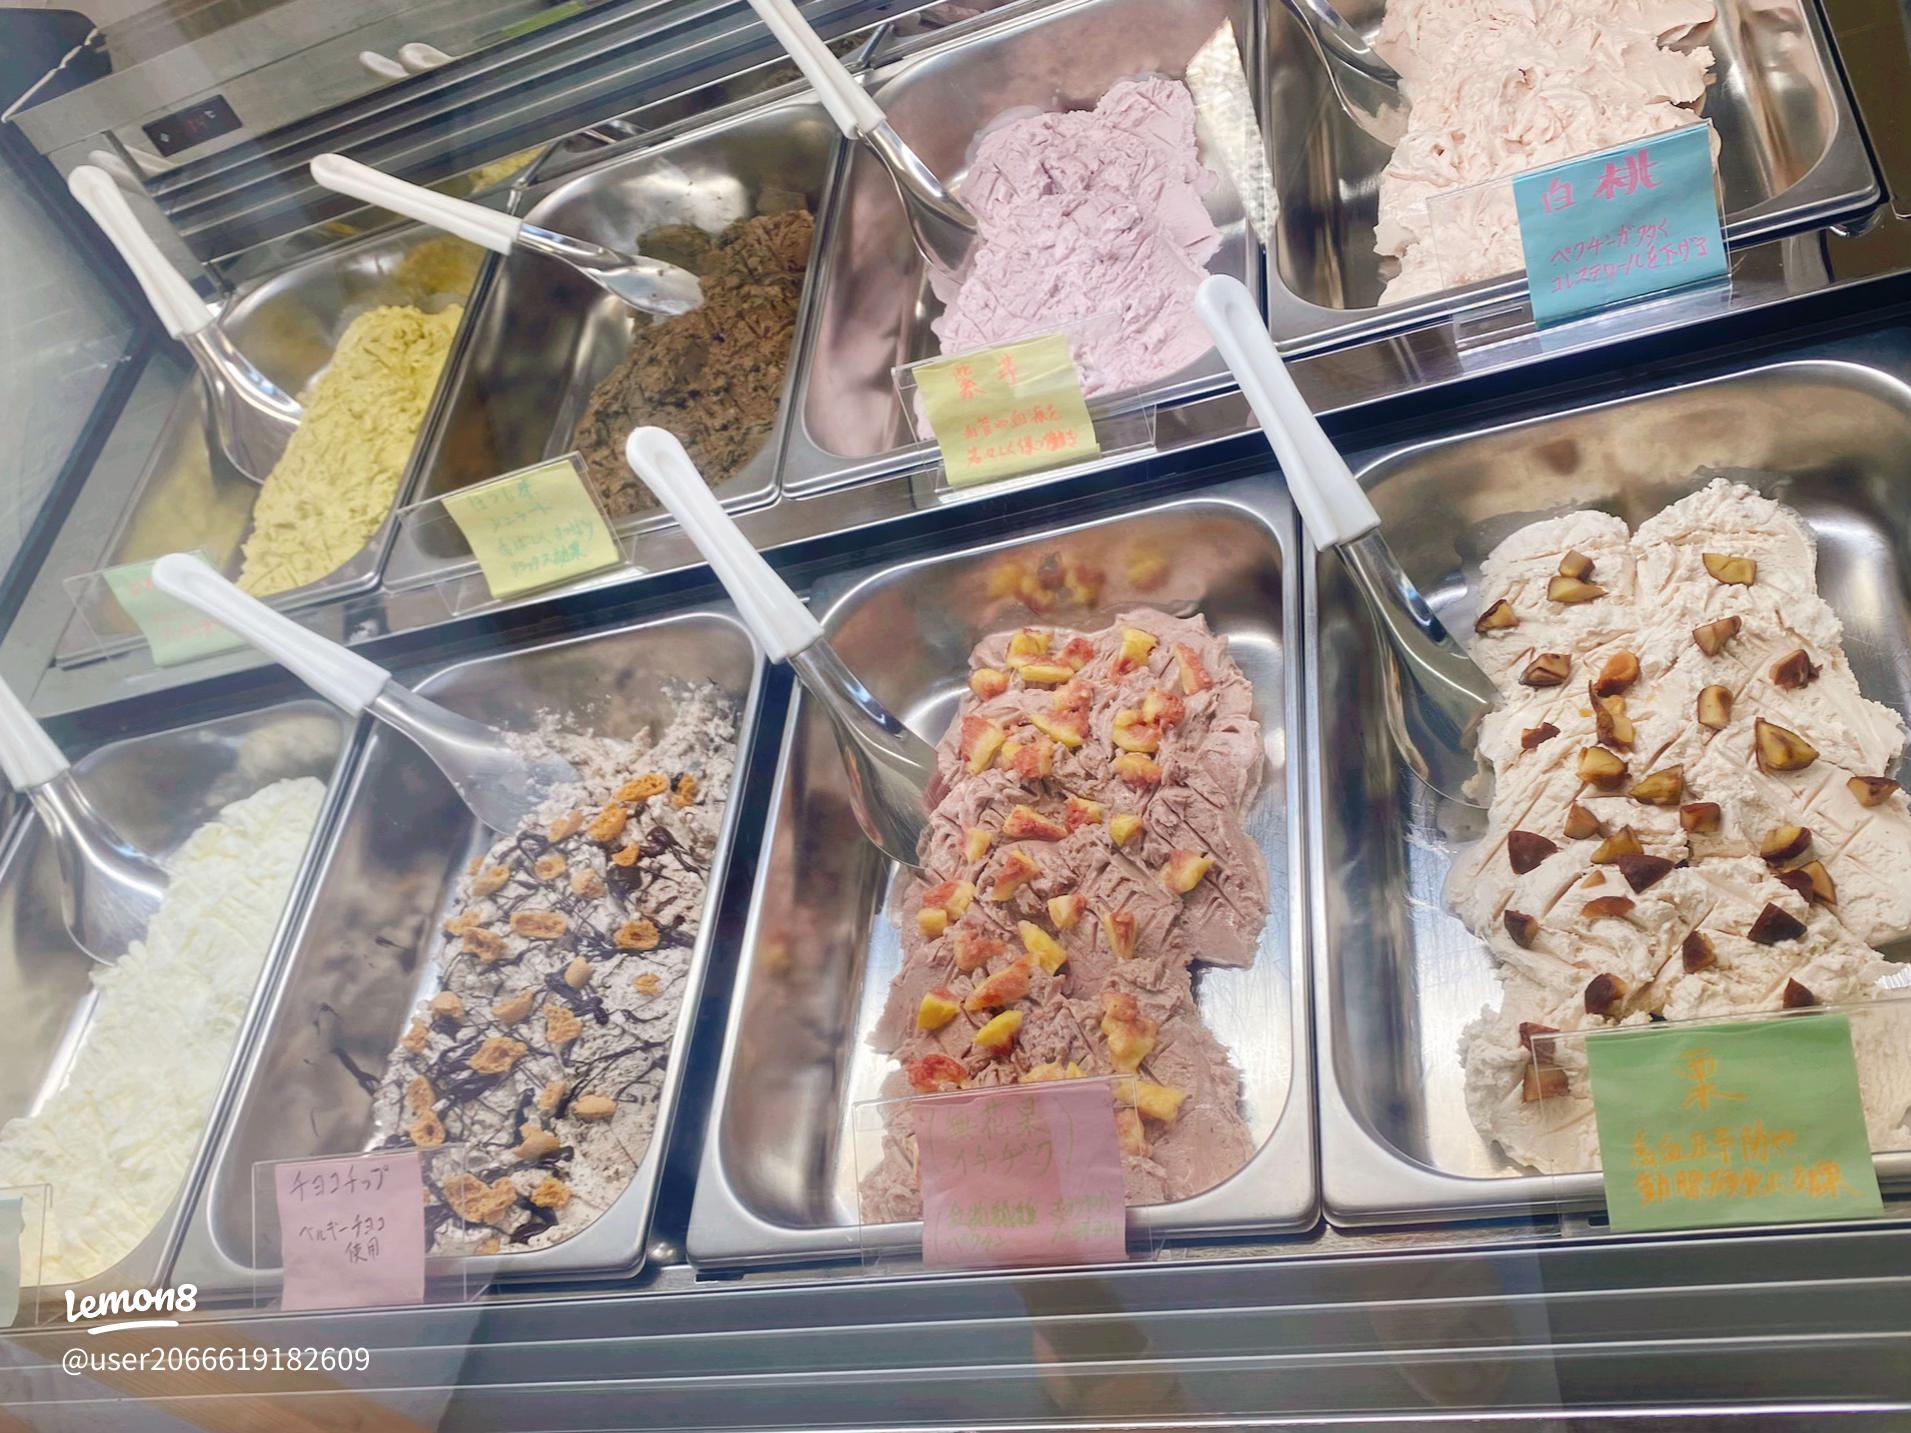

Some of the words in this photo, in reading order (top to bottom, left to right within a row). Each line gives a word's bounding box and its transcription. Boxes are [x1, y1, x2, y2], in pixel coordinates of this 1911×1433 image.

[1541, 148, 1662, 214] 白桃
[1674, 1047, 1749, 1112] 栗
[289, 1165, 390, 1202] チョコチップ
[344, 1237, 380, 1265] 使用
